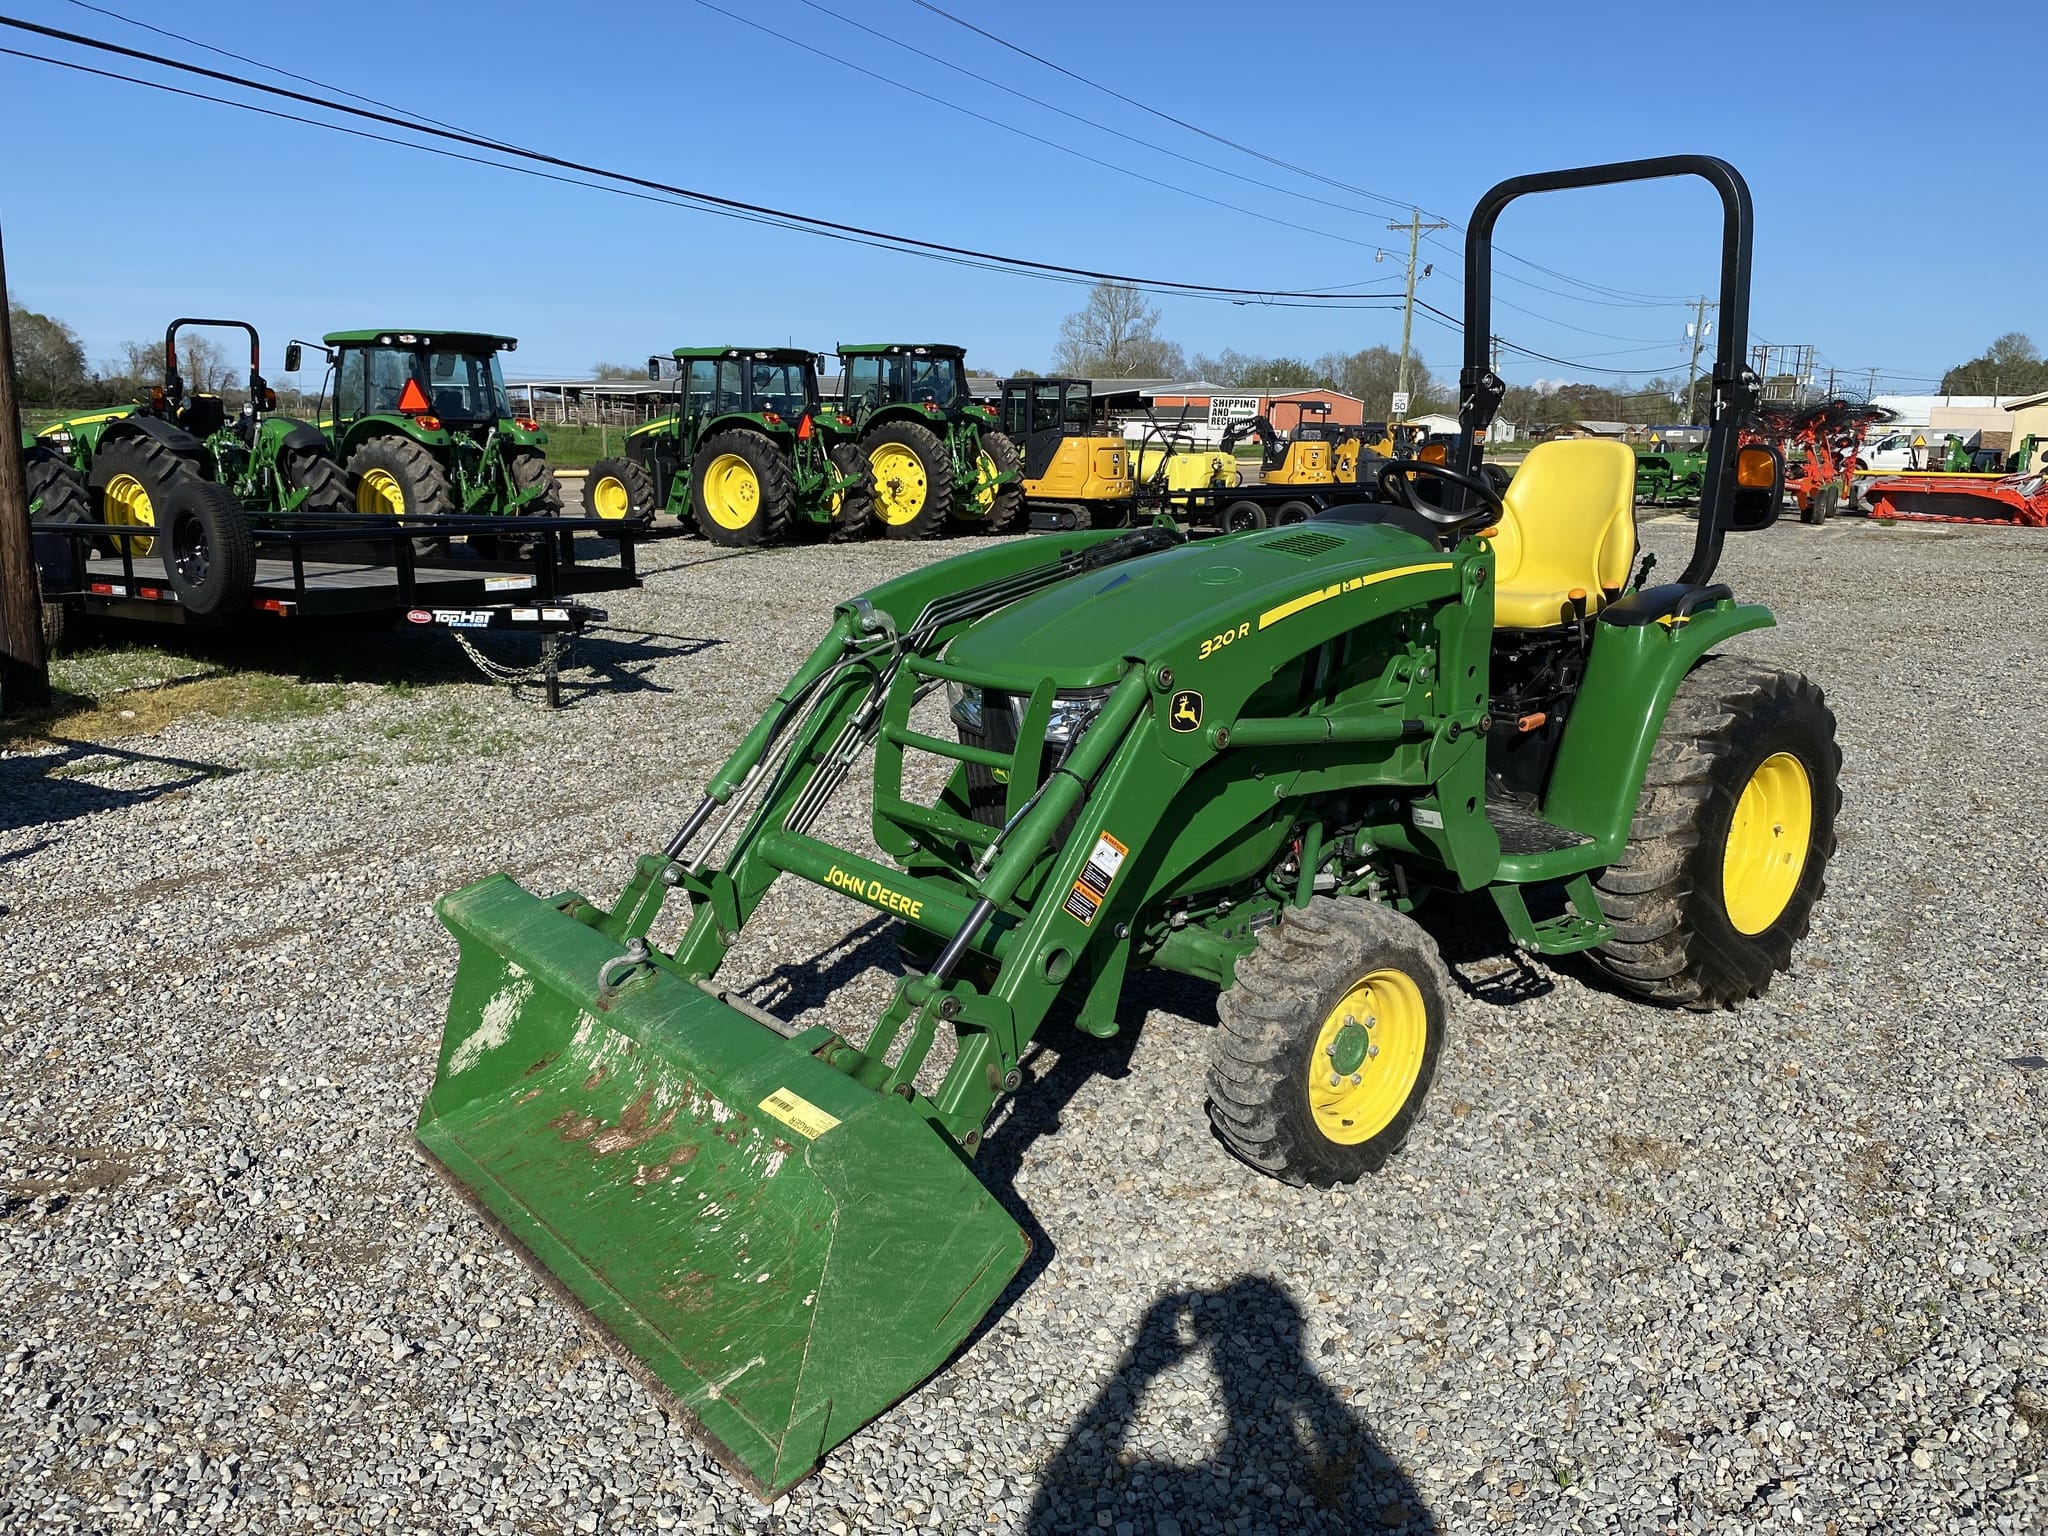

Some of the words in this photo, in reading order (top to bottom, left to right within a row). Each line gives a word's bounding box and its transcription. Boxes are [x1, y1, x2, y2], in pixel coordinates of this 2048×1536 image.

[1212, 398, 1257, 408] SHIPPING
[1394, 402, 1406, 410] 50
[1212, 408, 1229, 416] AND
[823, 865, 866, 896] JOHN
[867, 880, 923, 919] DEERE
